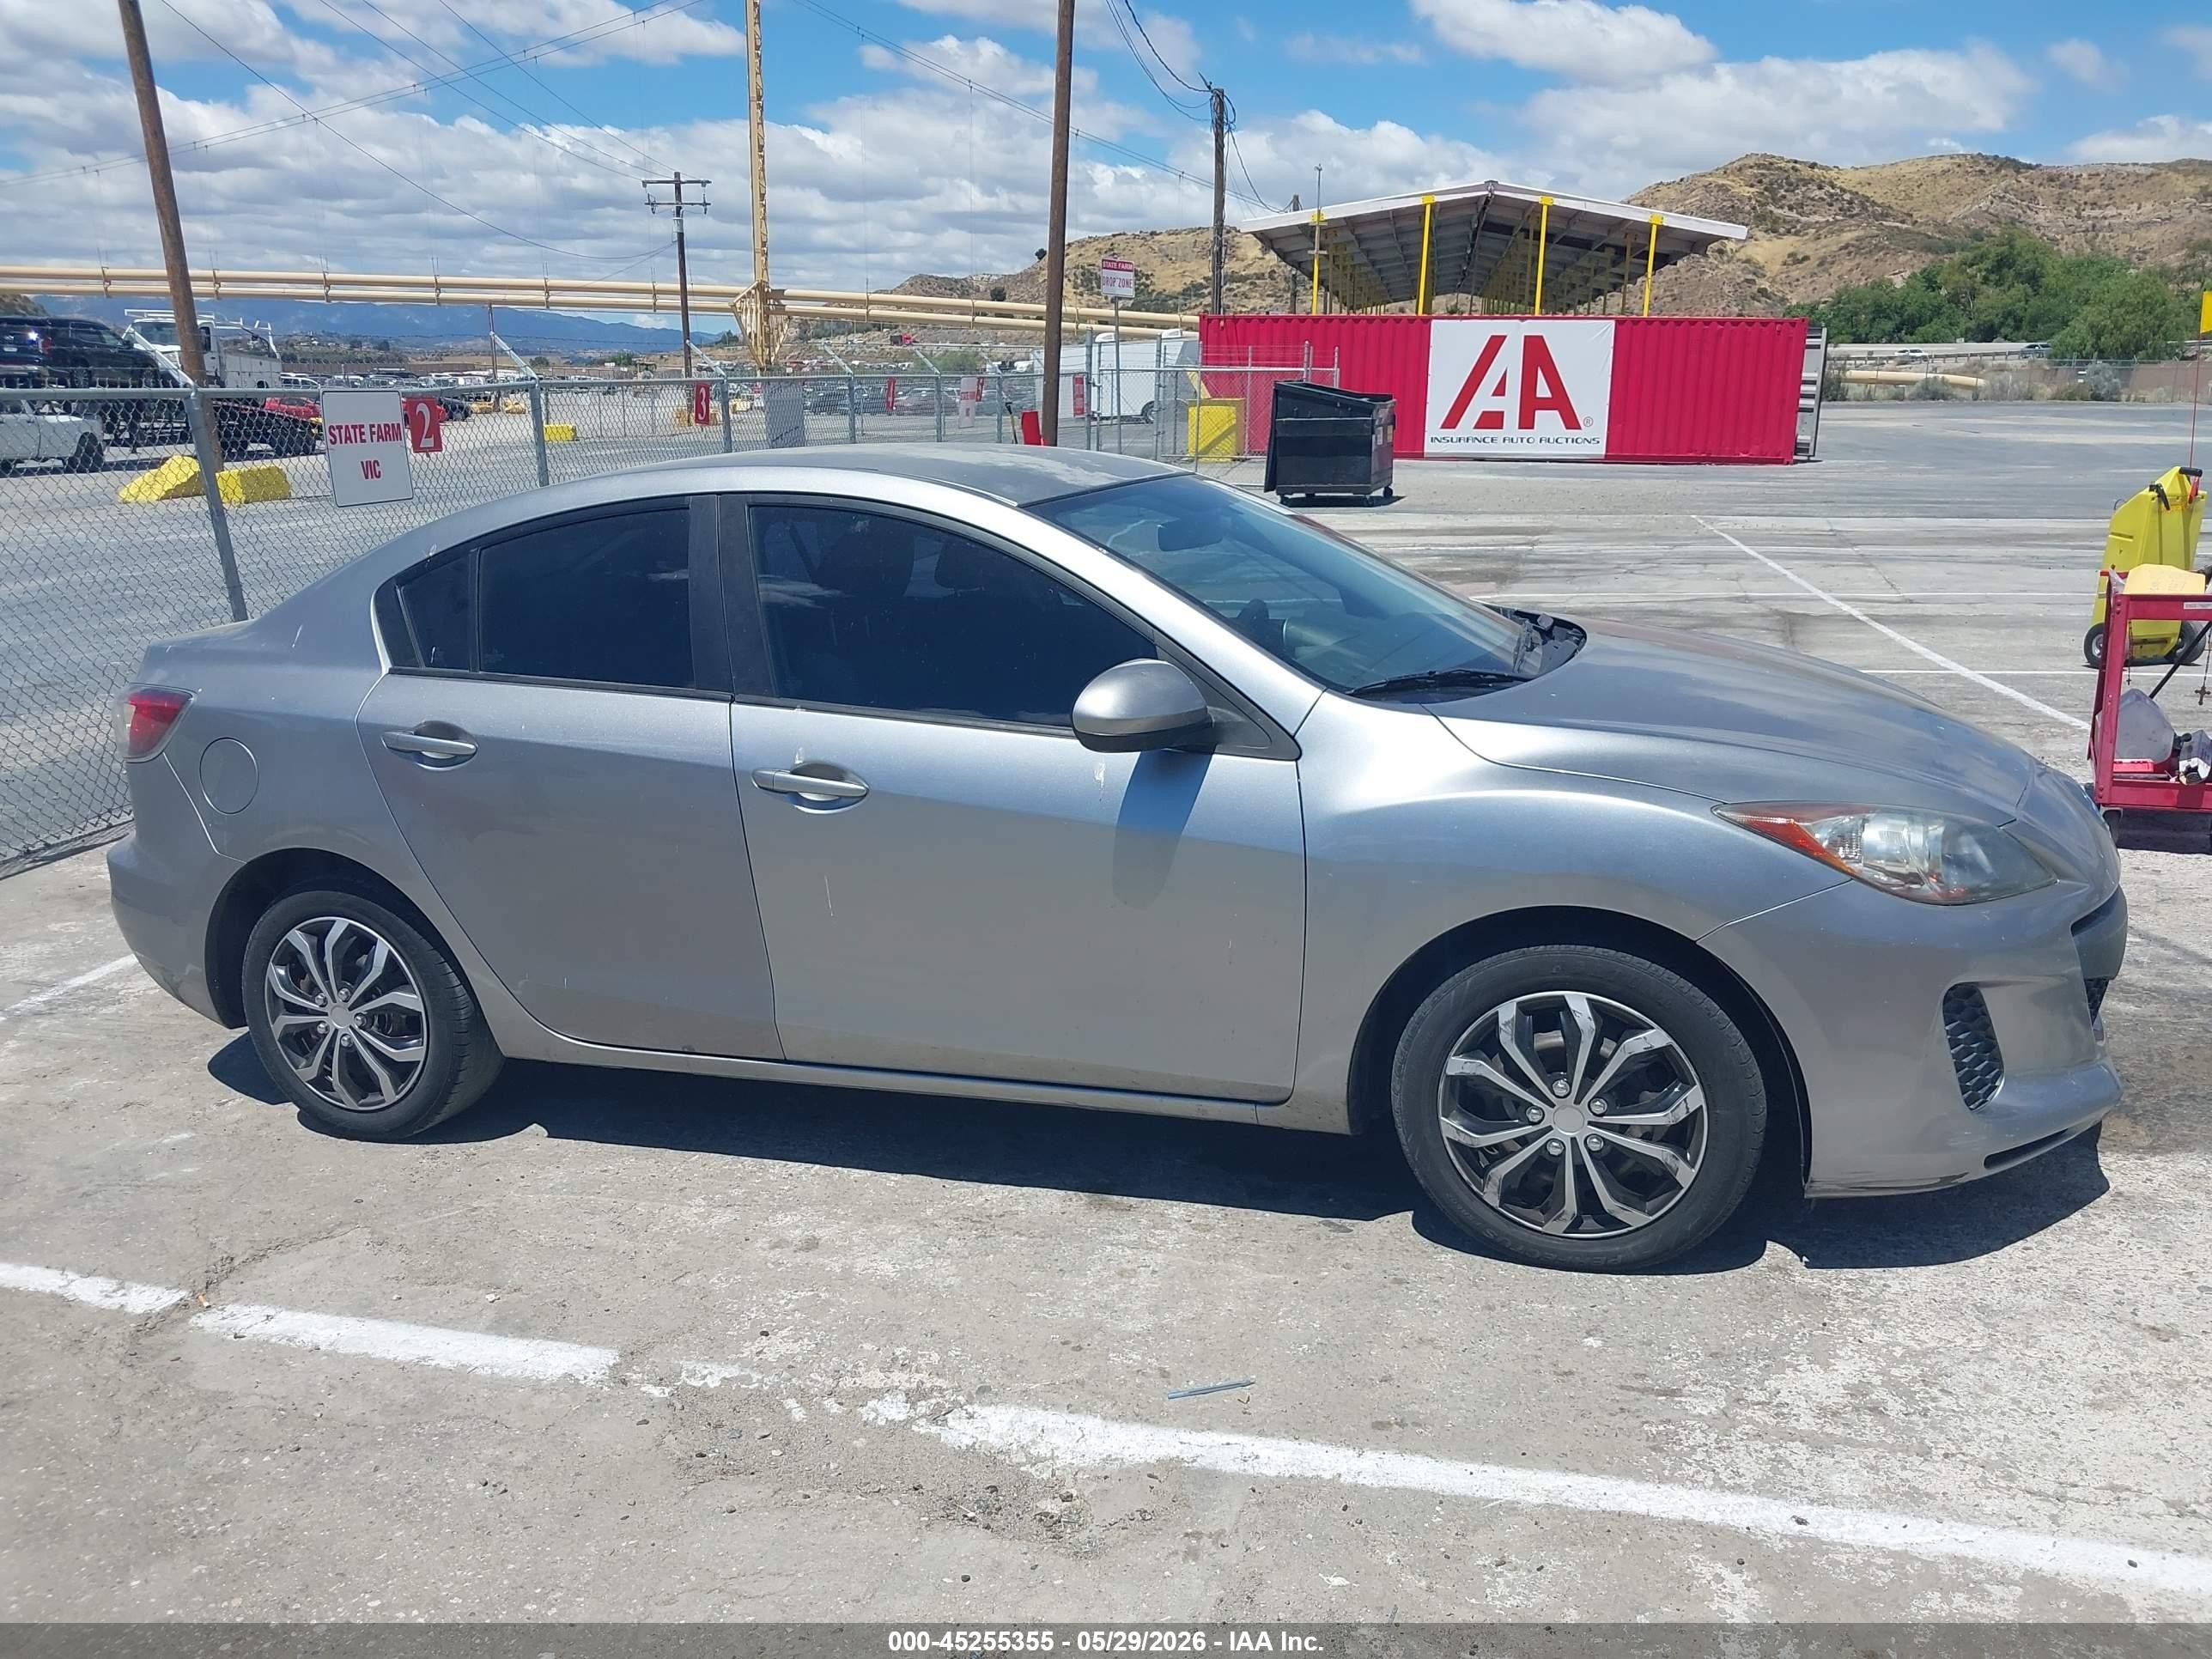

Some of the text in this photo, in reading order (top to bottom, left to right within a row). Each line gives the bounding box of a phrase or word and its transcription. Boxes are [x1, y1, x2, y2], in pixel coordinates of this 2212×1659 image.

[1103, 276, 1133, 289] DROP ZONE
[698, 386, 707, 421] 3
[328, 422, 403, 445] STATE FARM
[416, 402, 434, 448] 2
[1539, 436, 1601, 445] AUCTIONS
[361, 459, 381, 480] VIC
